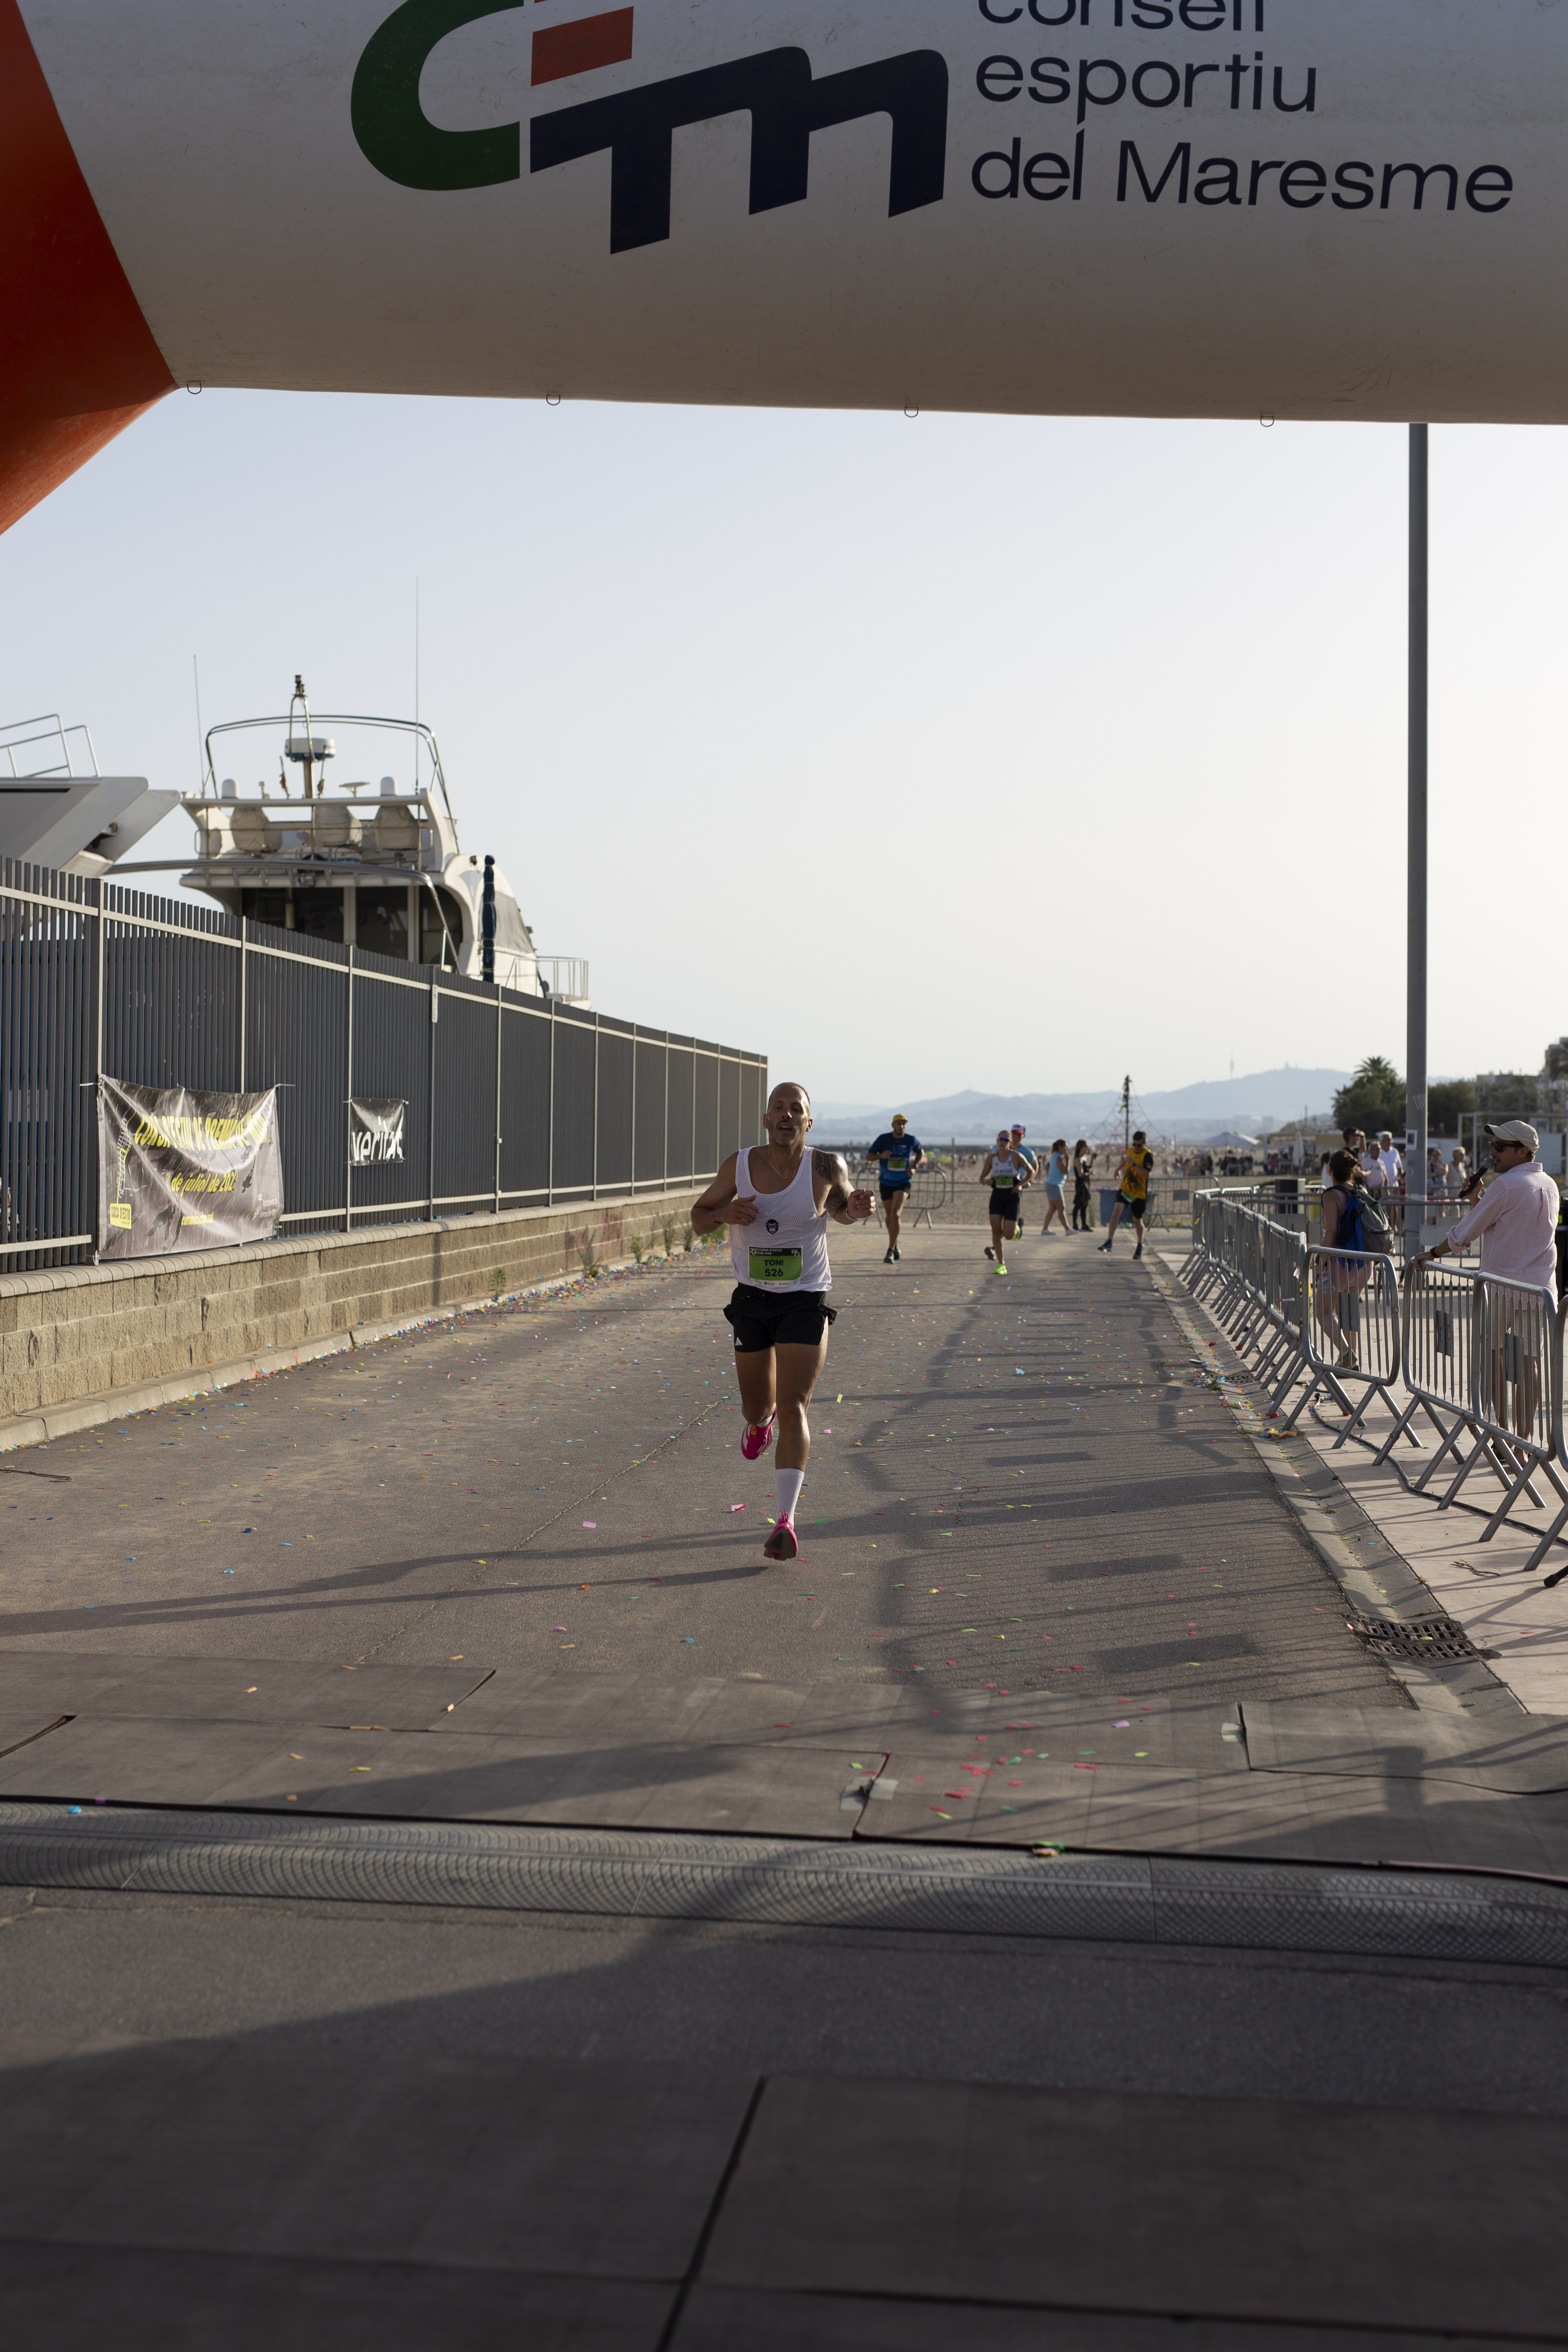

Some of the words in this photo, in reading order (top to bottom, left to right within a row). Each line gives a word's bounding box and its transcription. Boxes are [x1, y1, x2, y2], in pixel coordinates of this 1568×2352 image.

[976, 51, 1317, 126] esportiu
[971, 128, 1085, 201] del
[1116, 140, 1513, 213] Maresme
[171, 1172, 184, 1192] de
[180, 1173, 211, 1198] juliol
[207, 1173, 220, 1192] de
[765, 1268, 784, 1277] 526
